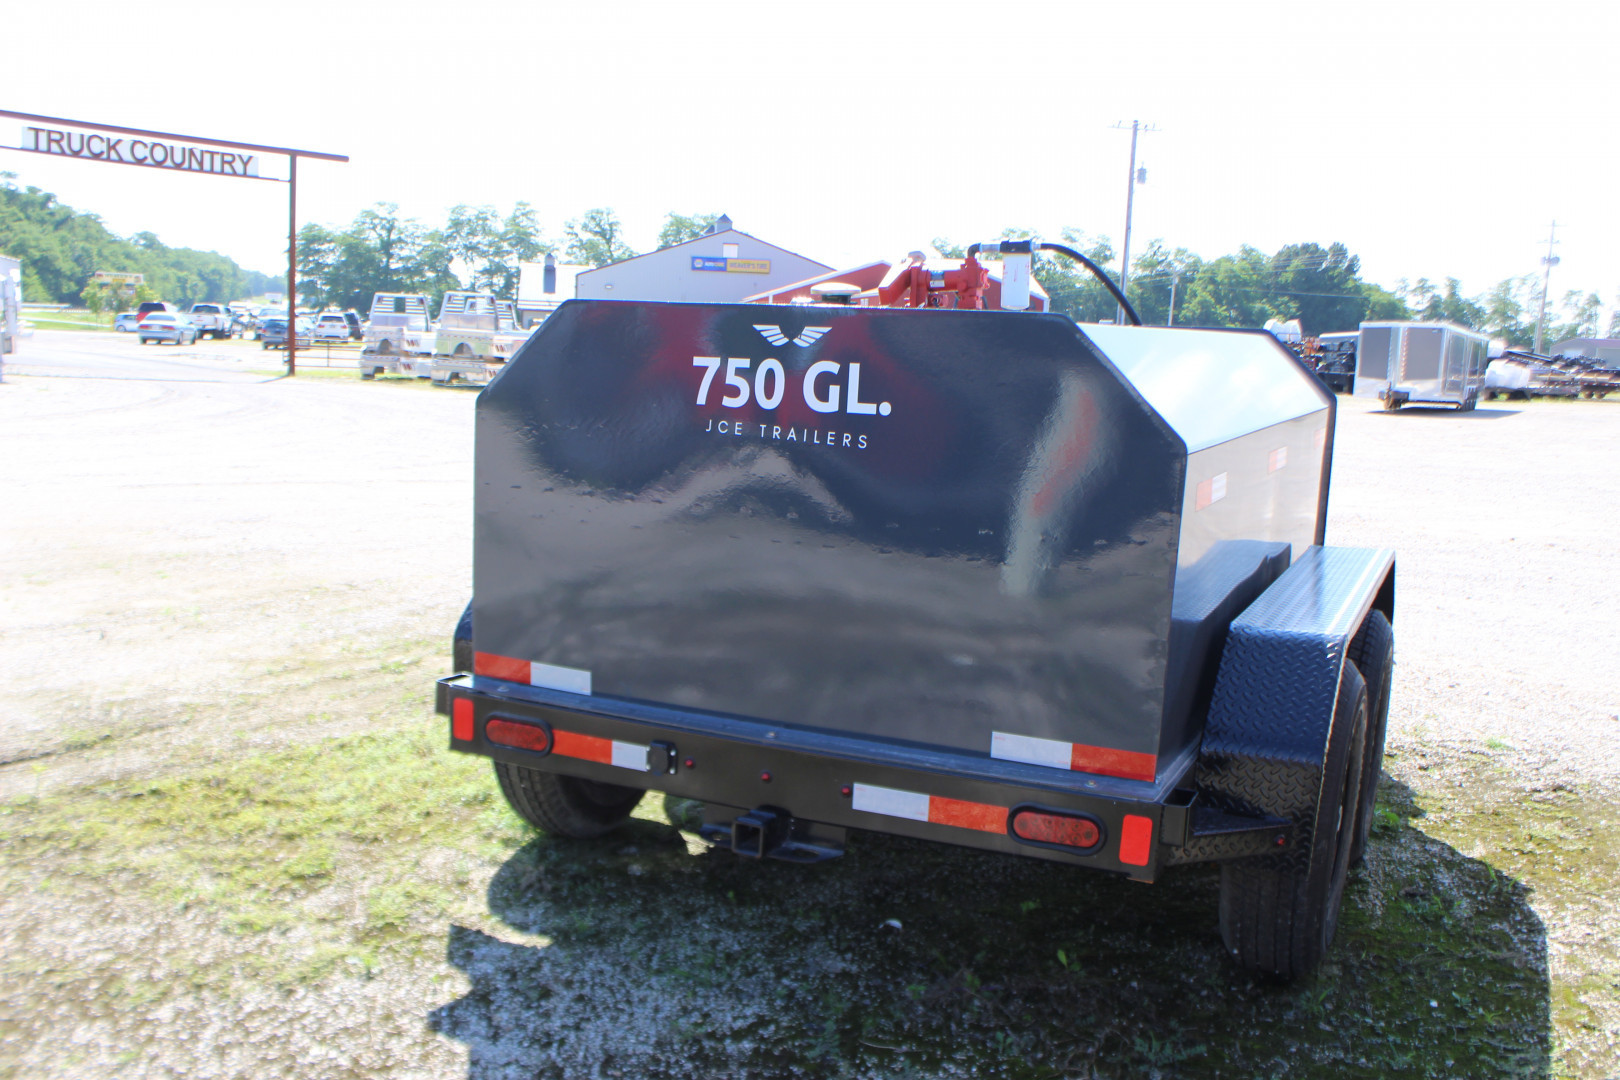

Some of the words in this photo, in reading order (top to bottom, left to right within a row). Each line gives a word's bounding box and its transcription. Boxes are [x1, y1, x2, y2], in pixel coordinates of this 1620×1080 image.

[27, 126, 123, 162] TRUCK
[129, 139, 254, 176] COUNTRY
[693, 356, 786, 410] 750
[803, 360, 892, 417] GL.
[705, 419, 743, 436] JCE
[759, 424, 868, 449] TRAILERS
